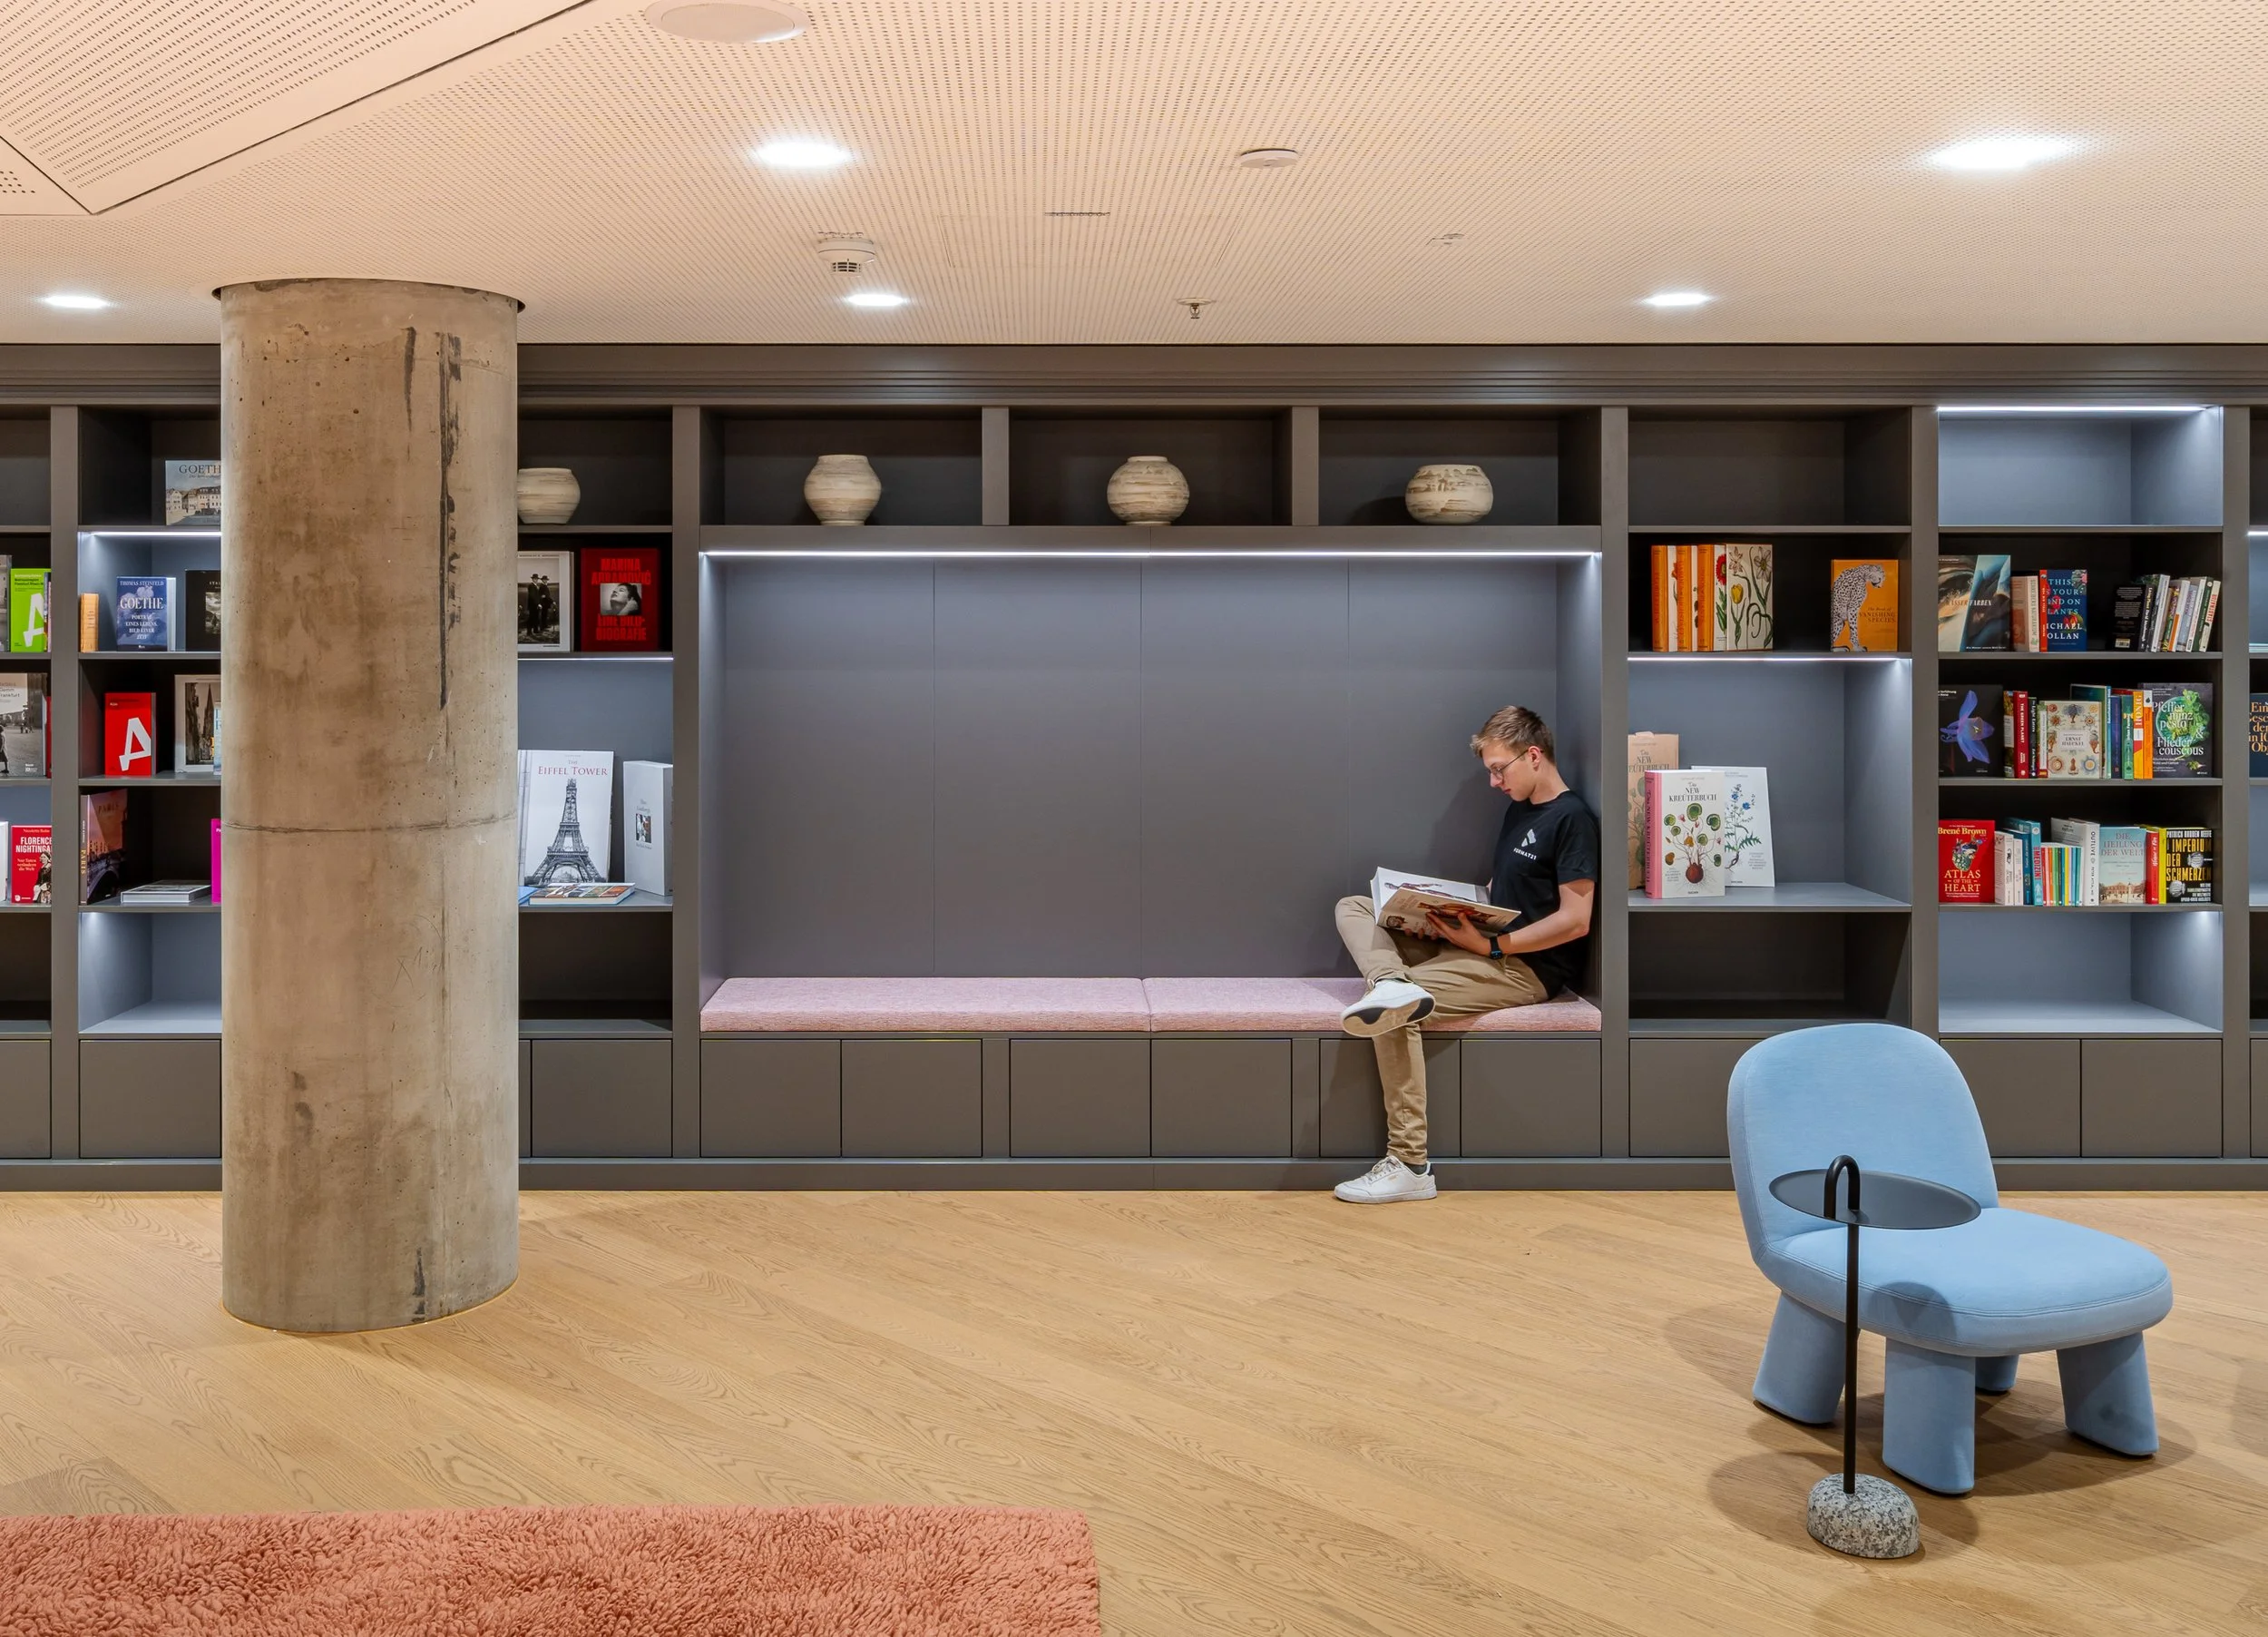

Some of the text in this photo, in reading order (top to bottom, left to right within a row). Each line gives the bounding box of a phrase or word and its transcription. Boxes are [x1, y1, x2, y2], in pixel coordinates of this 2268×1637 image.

[179, 465, 221, 473] GOETH
[601, 559, 640, 570] MARINA
[120, 597, 164, 609] GOETHE
[2153, 701, 2185, 712] Pfeffer
[2251, 702, 2268, 713] Ein
[2250, 714, 2268, 722] esc
[2160, 720, 2187, 731] pesto
[2251, 742, 2268, 752] Ob
[538, 766, 607, 775] EIFFEL TOWER
[1629, 763, 1669, 772] EÜTERBUCH
[2167, 853, 2181, 867] DER
[1944, 870, 1981, 878] ATLAS
[2166, 867, 2211, 881] SCHMERZEN
